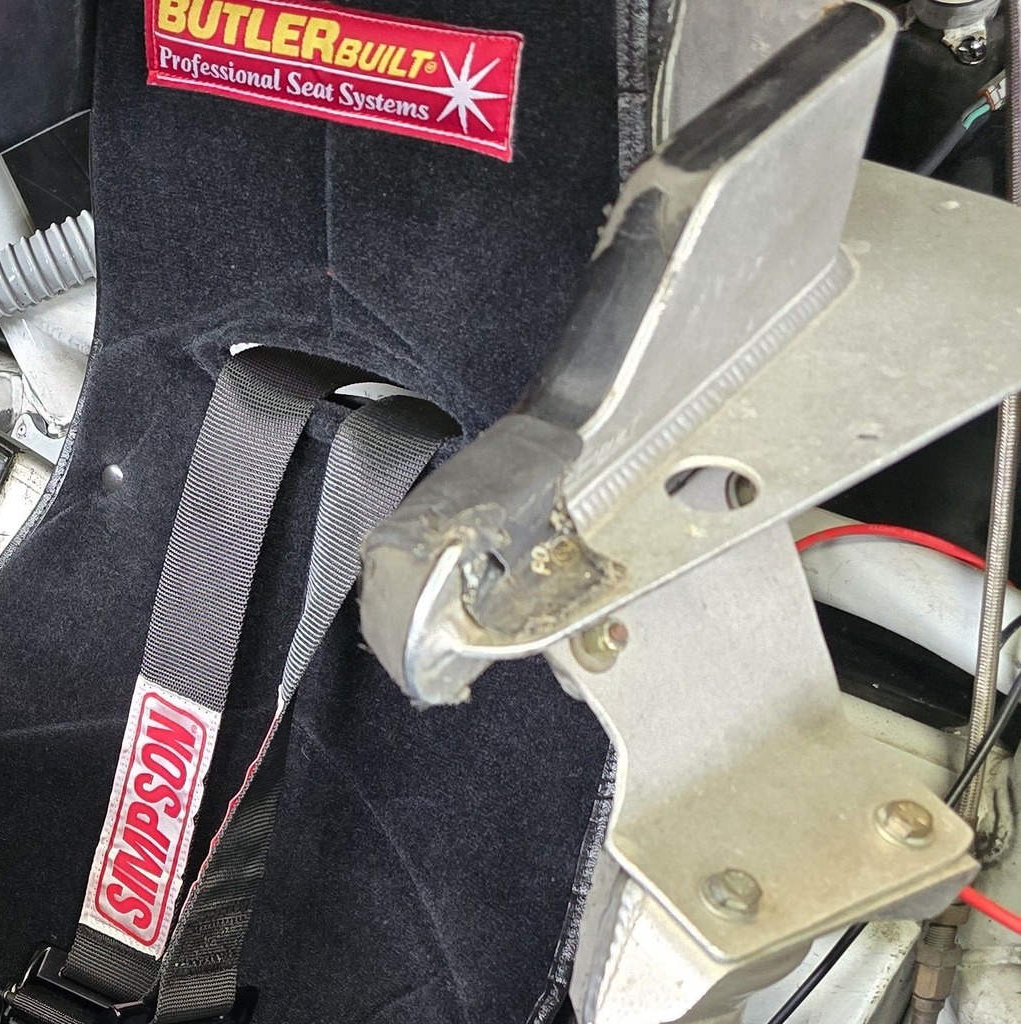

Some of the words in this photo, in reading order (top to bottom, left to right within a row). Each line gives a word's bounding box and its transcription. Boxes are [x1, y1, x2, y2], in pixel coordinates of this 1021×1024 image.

[159, 45, 280, 92] Professional
[287, 72, 333, 104] Seat
[339, 84, 430, 121] Systems
[106, 709, 196, 930] SIMPSON
